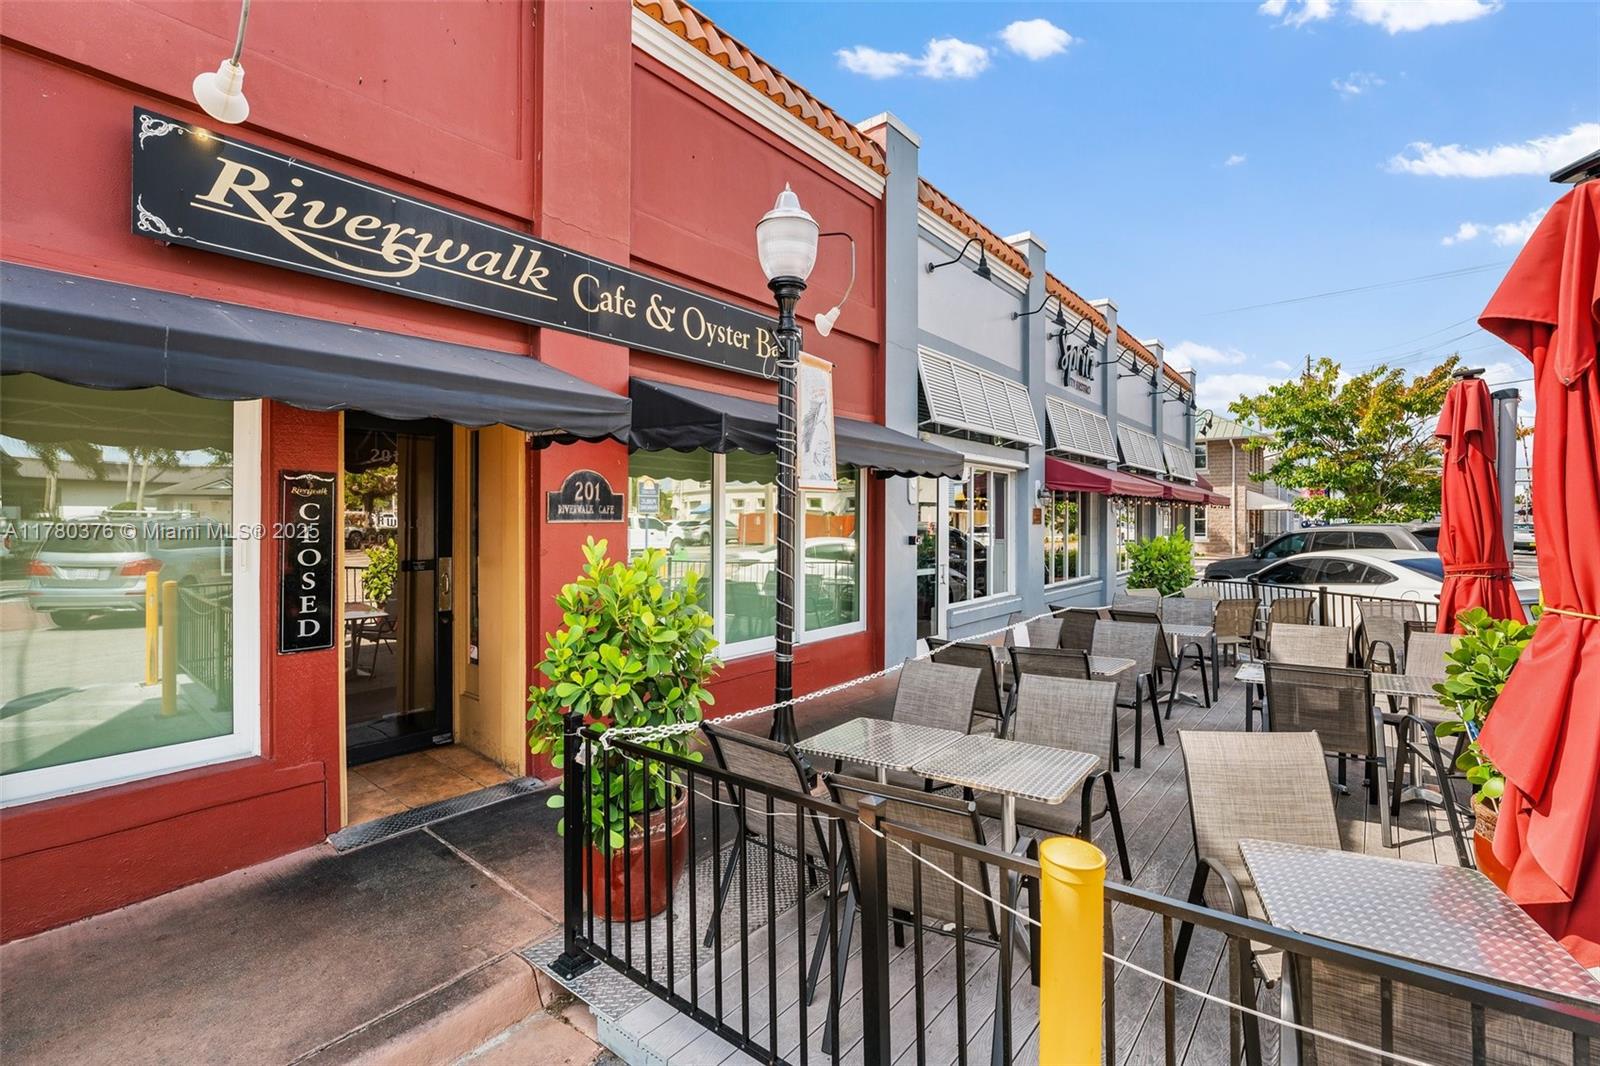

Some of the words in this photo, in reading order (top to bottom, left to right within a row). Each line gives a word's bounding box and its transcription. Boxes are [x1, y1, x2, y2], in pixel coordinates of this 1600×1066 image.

[194, 156, 552, 292] Riverwalk
[573, 273, 636, 319] Cafe
[645, 294, 676, 333] &
[682, 306, 750, 351] Oyster
[755, 326, 779, 358] Ba
[290, 485, 329, 498] Riverwalk
[574, 481, 601, 502] 201
[557, 504, 594, 515] RIVERWALK
[598, 504, 615, 514] CAFE
[296, 502, 322, 638] CLOSED
